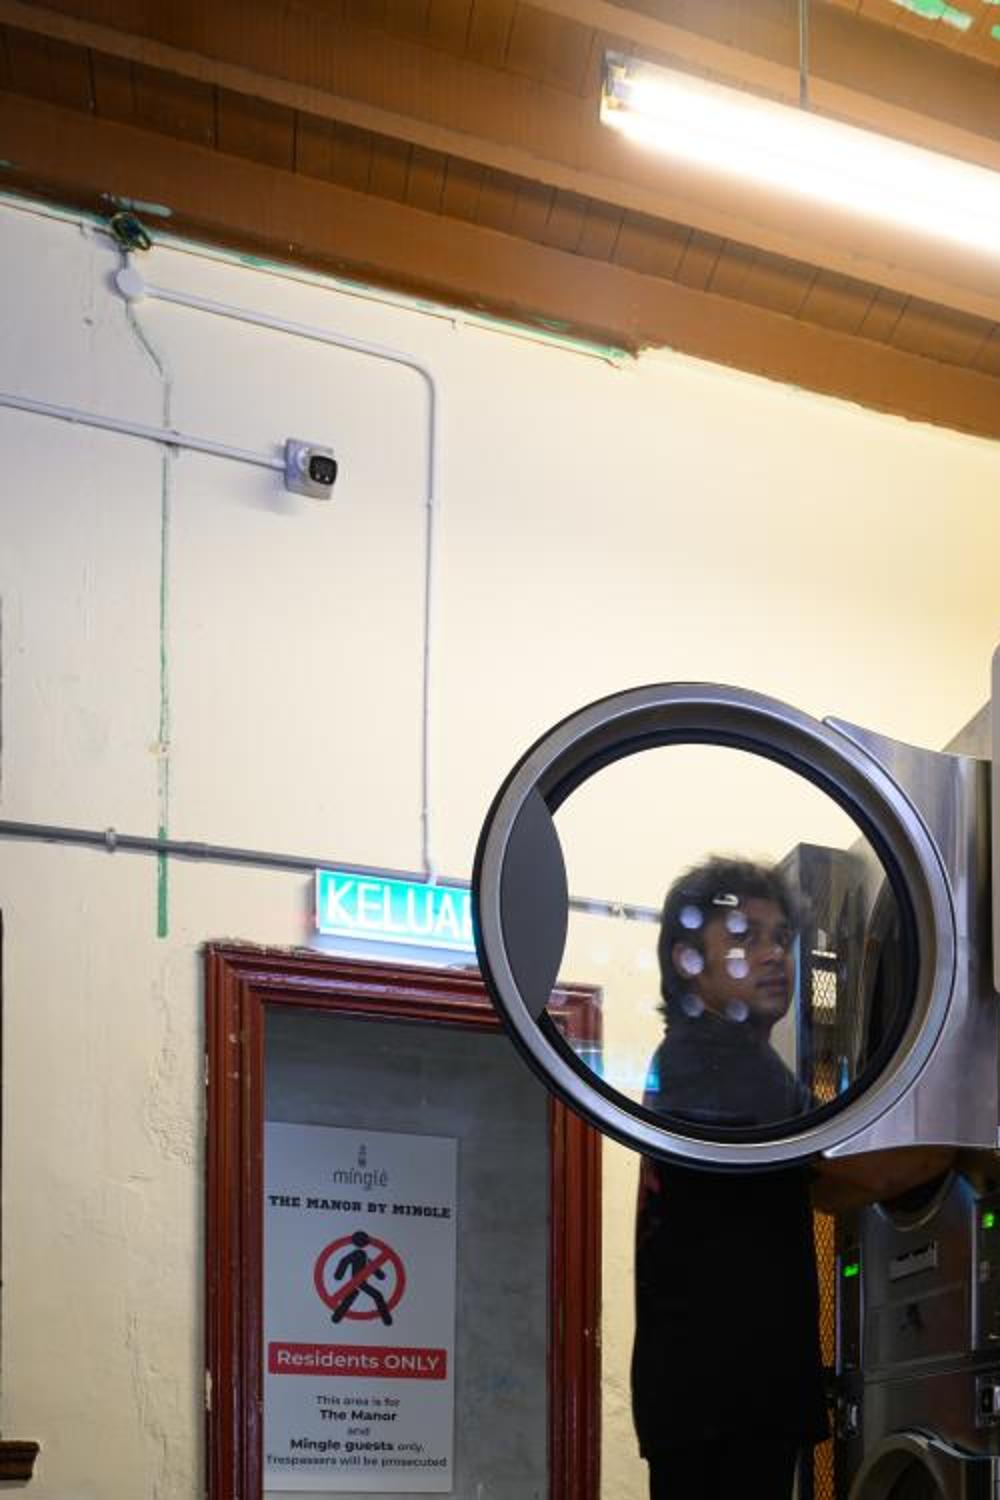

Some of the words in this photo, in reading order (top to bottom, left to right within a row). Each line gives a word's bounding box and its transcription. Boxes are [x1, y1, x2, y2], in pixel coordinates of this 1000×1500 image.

[268, 1195, 301, 1207] THE
[306, 1197, 362, 1212] MANOR
[367, 1202, 387, 1213] BY
[393, 1204, 451, 1218] MINGLE
[277, 1350, 379, 1368] Residents
[384, 1355, 439, 1371] ONLY
[317, 1395, 341, 1406] This
[343, 1397, 369, 1406] area
[373, 1397, 382, 1406] is
[384, 1397, 400, 1407] for
[320, 1409, 347, 1421] The
[351, 1410, 397, 1422] Manor
[347, 1427, 371, 1436] and
[290, 1437, 341, 1452] Mingle
[345, 1440, 394, 1453] guests
[267, 1455, 337, 1466] Trespassers
[340, 1456, 361, 1466] will
[363, 1456, 378, 1466] be
